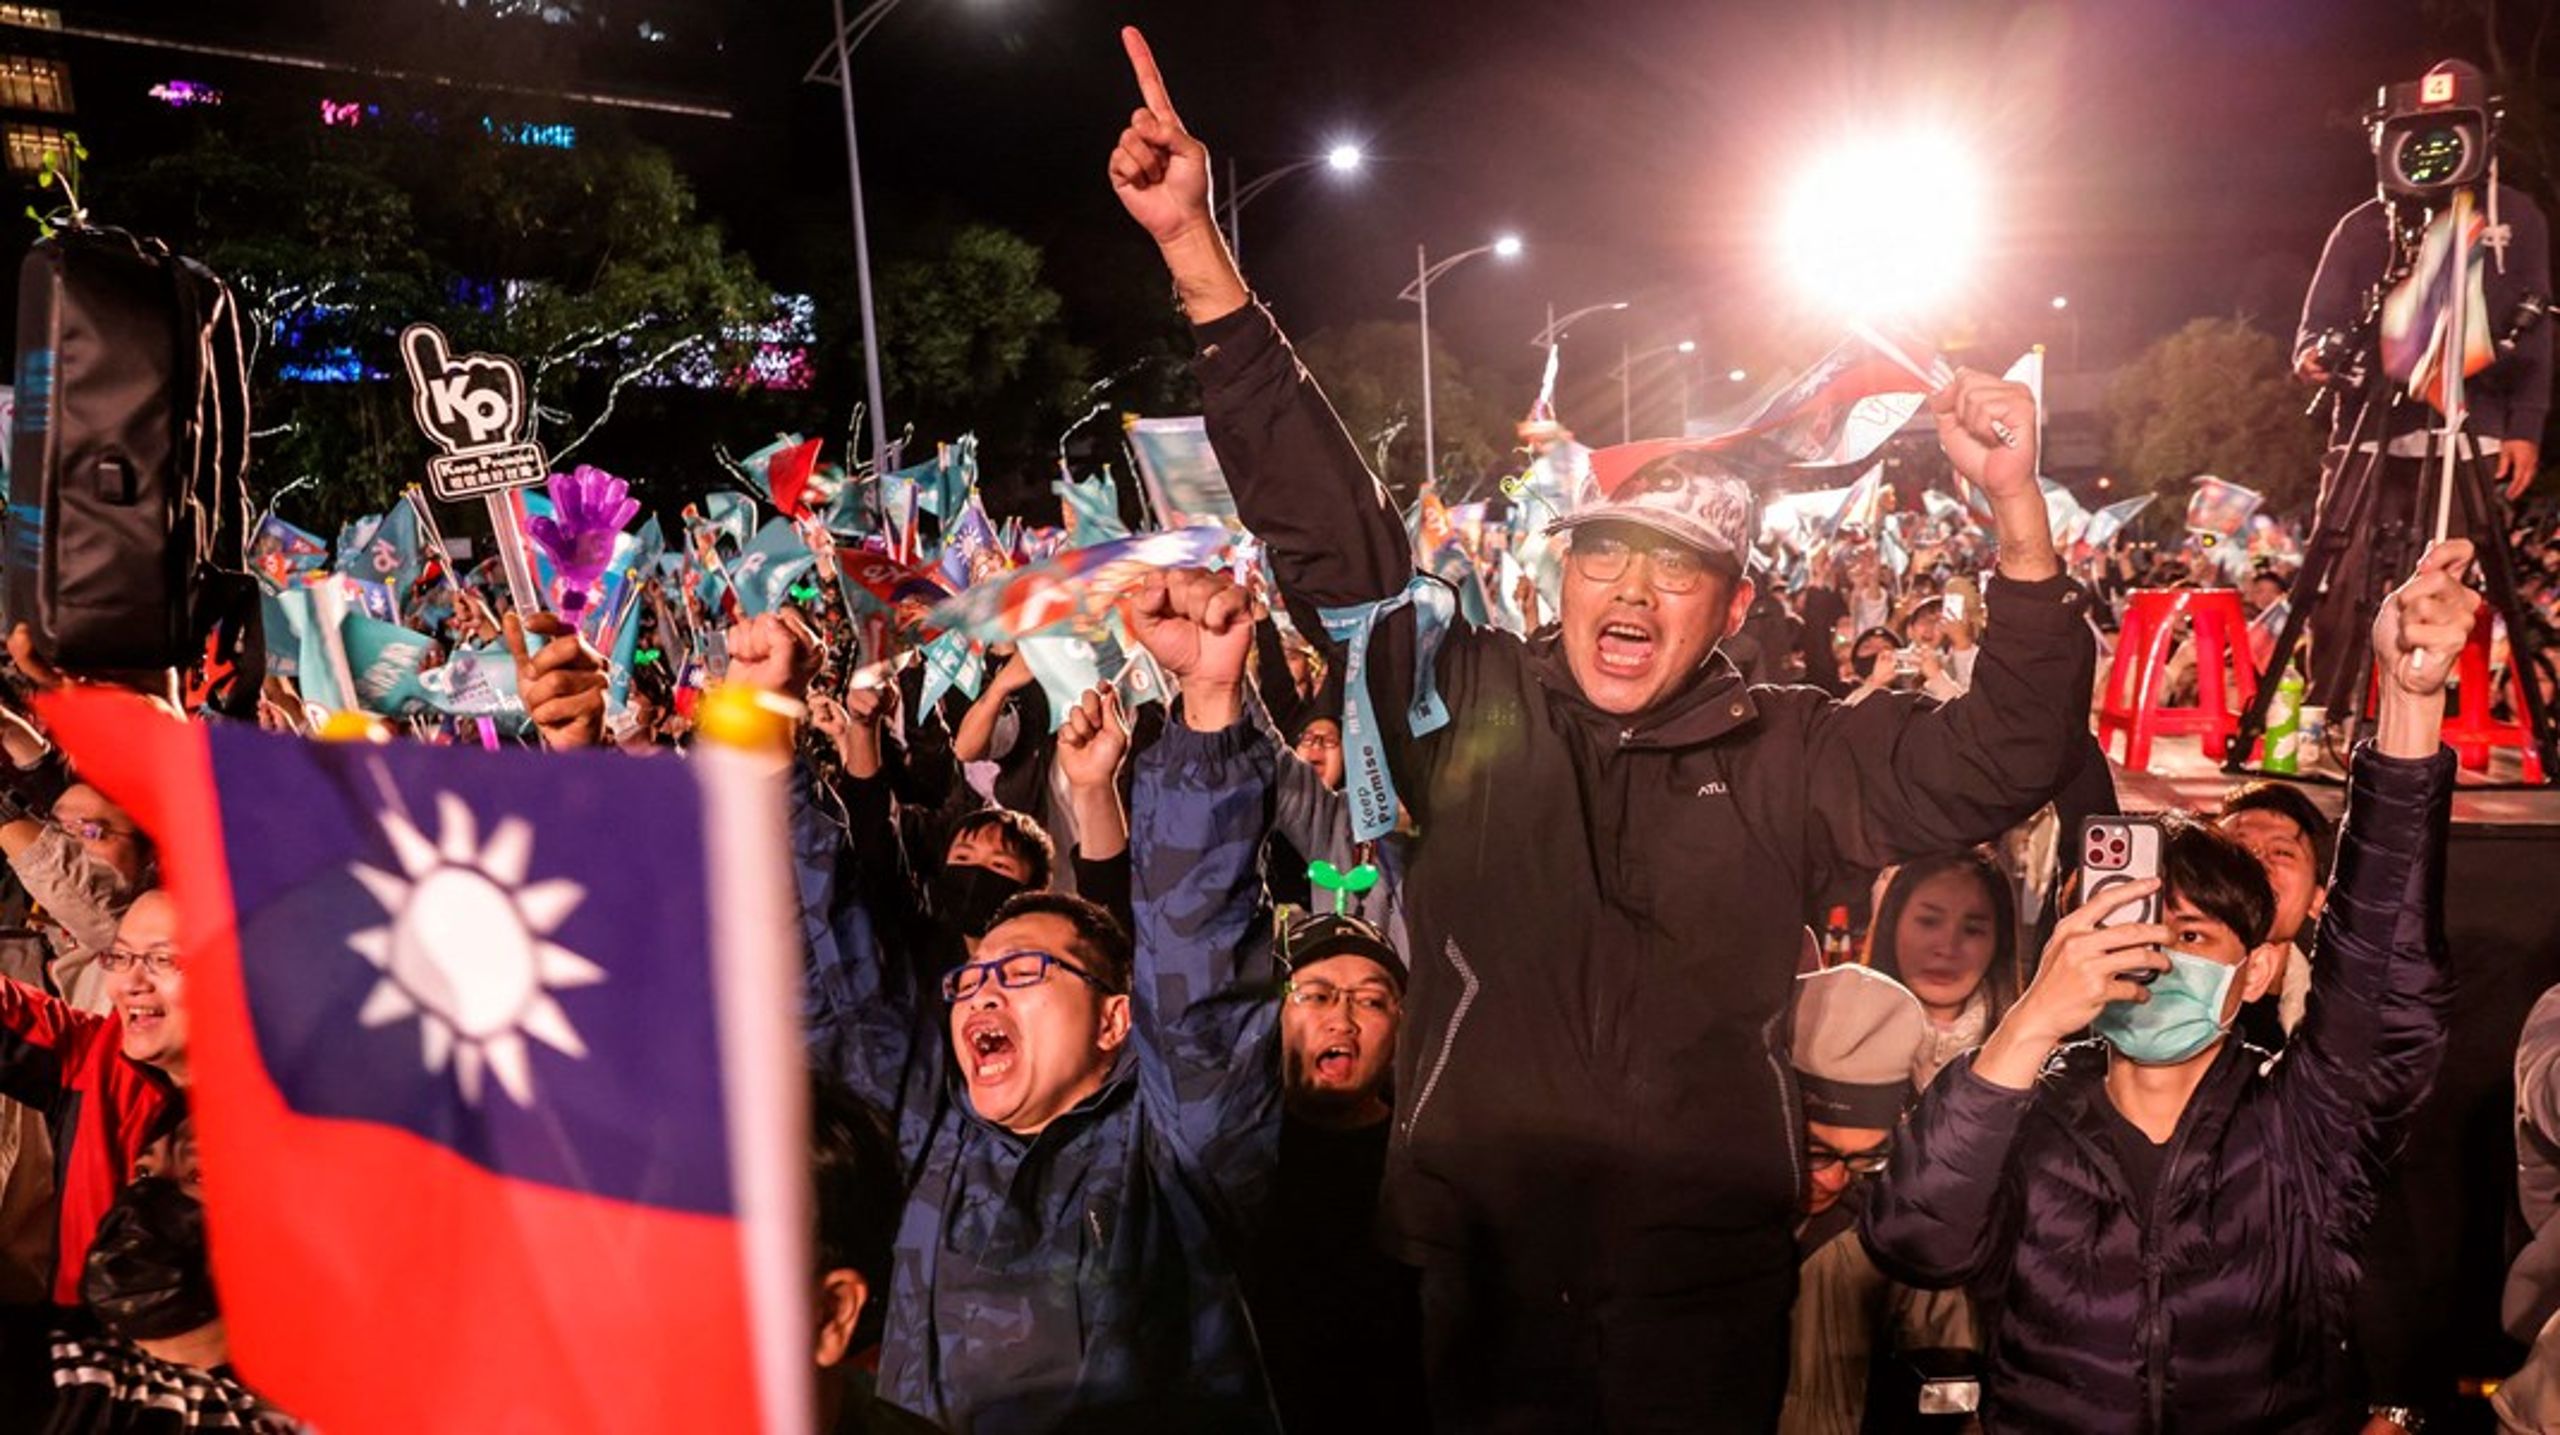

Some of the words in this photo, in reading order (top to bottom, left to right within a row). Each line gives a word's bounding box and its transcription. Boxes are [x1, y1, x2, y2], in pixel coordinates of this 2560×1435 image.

[440, 461, 479, 477] Keep
[1363, 746, 1391, 824] Promise
[1357, 786, 1376, 829] Keep
